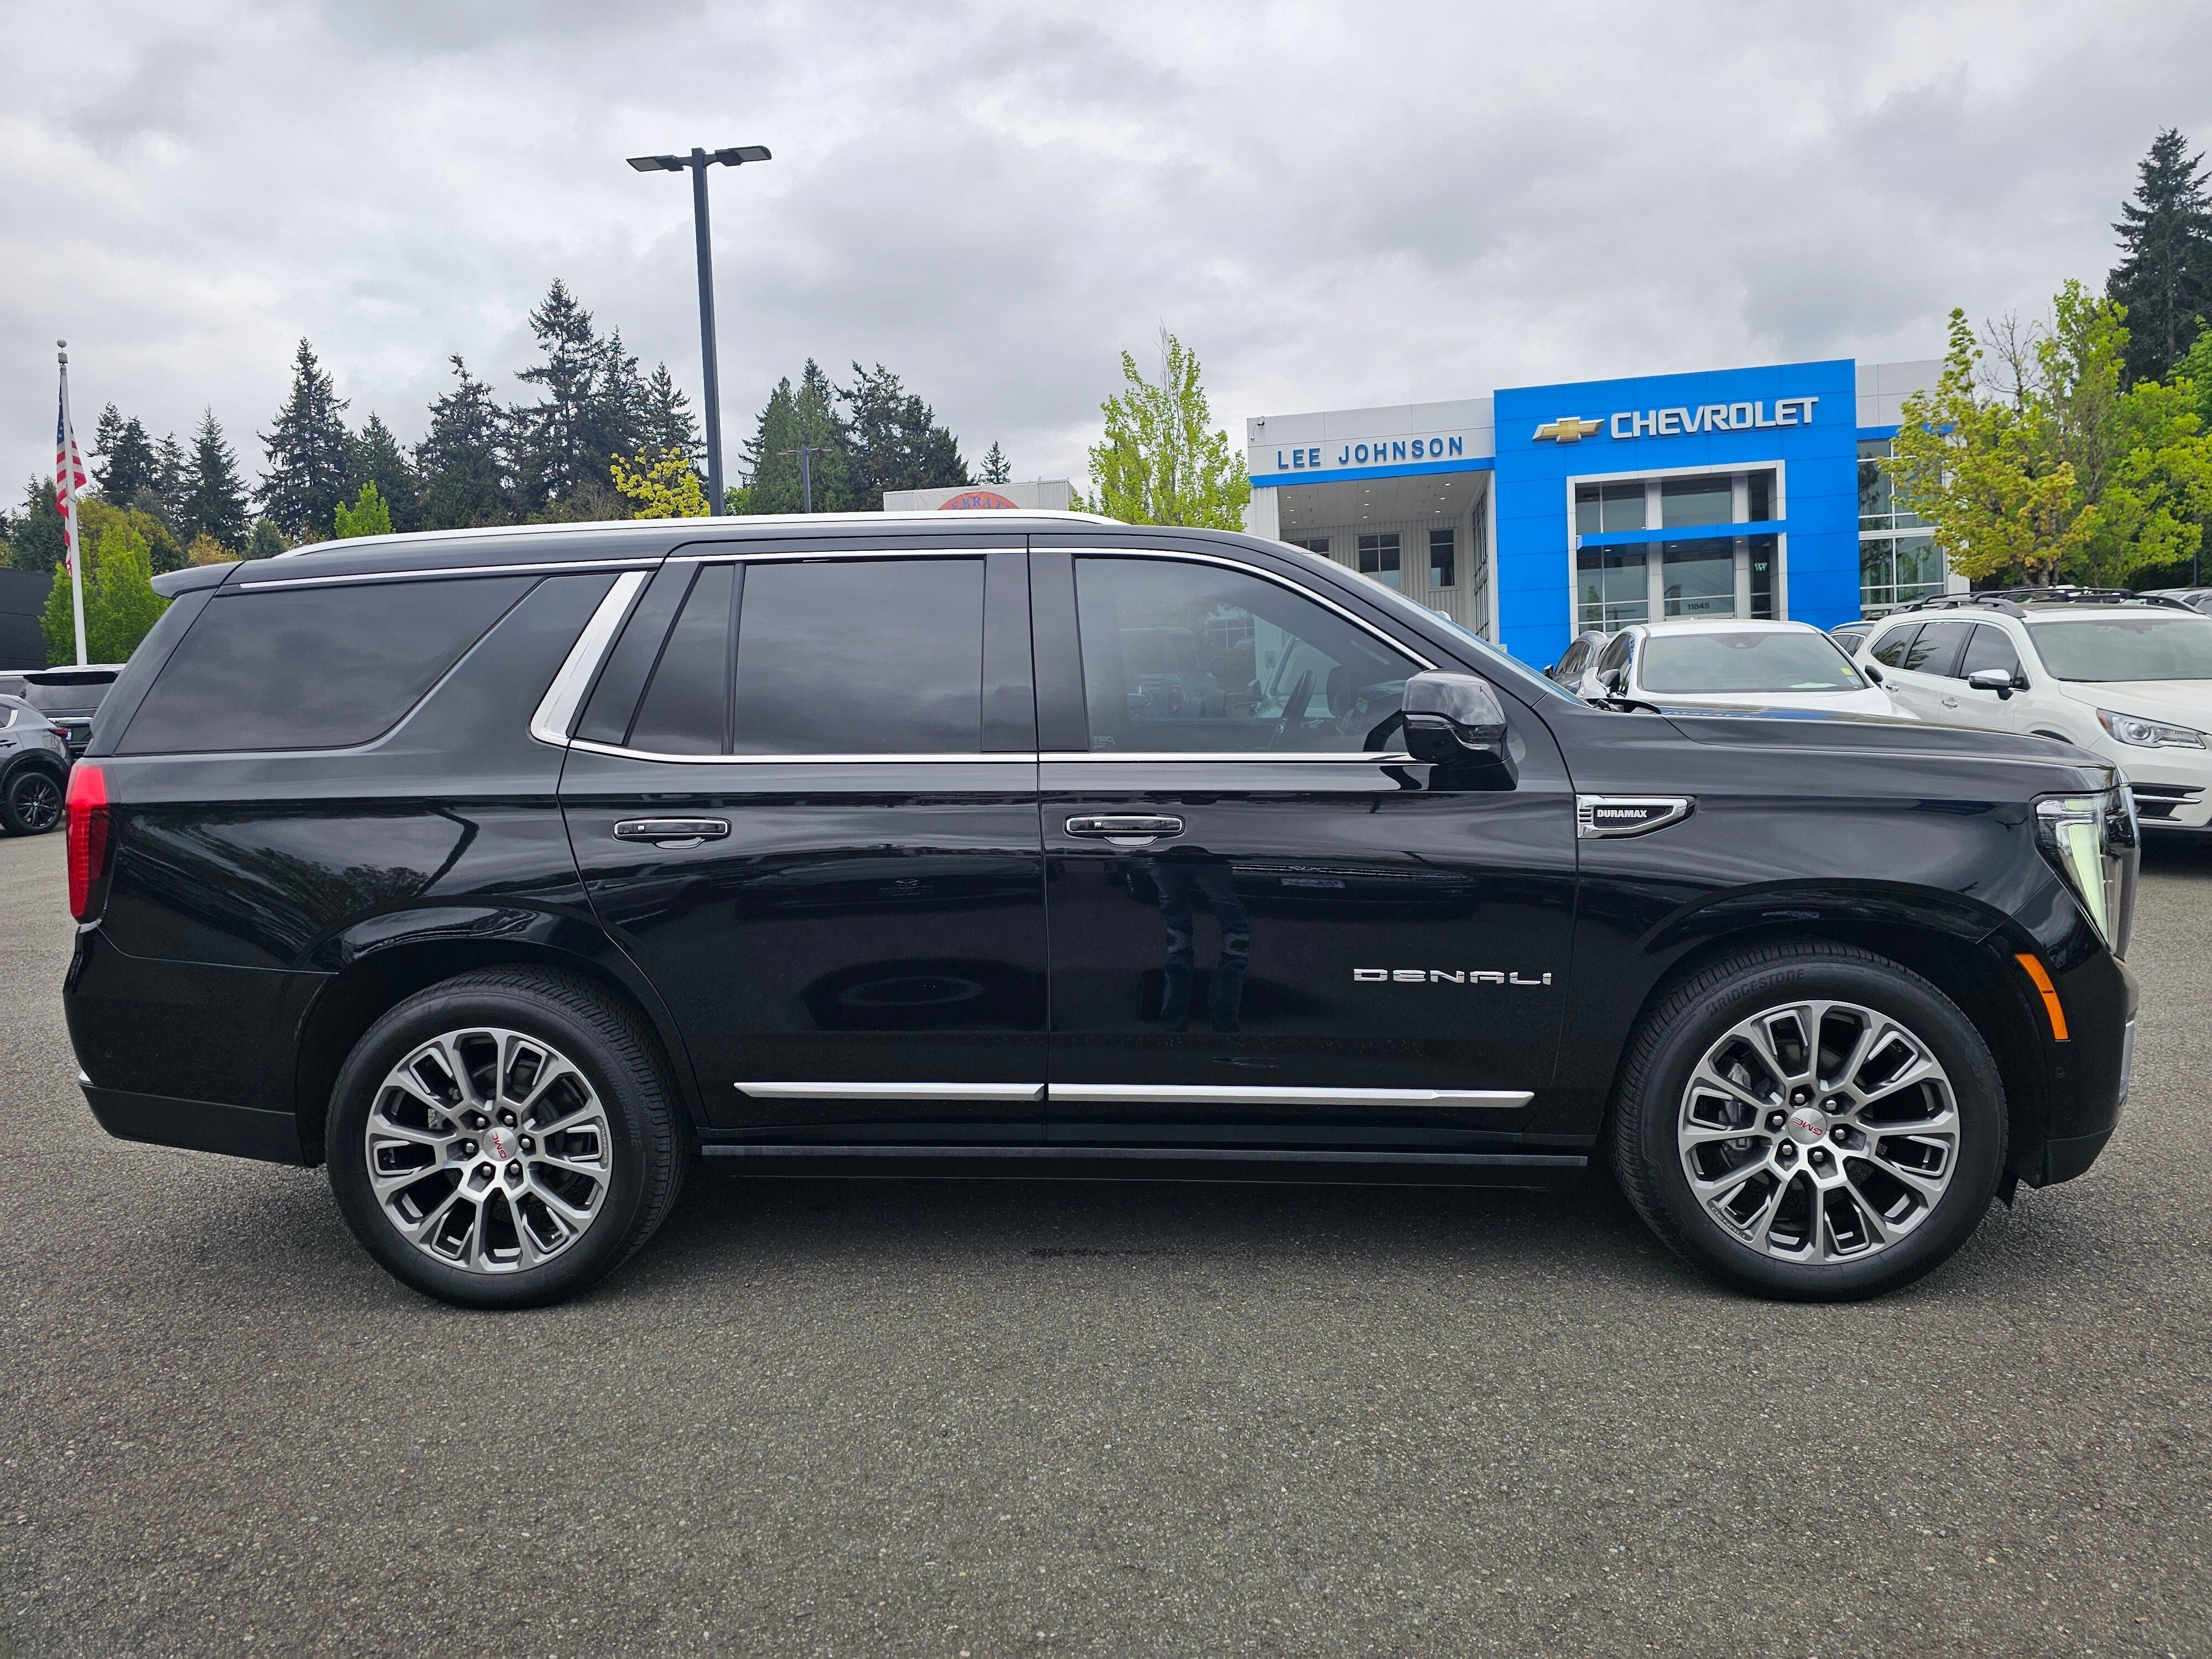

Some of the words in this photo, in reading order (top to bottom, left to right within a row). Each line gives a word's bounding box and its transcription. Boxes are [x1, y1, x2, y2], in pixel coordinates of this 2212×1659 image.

[1610, 397, 1819, 439] CHEVROLET
[1277, 447, 1321, 469] LEE
[1338, 436, 1463, 465] JOHNSON
[1755, 562, 1767, 571] W
[1597, 809, 1647, 818] DURAMAX
[1354, 968, 1552, 985] DENALI
[1705, 968, 1805, 1017] BRIDGESTONE
[1793, 1117, 1823, 1136] GMC
[491, 1131, 507, 1159] GMC
[1711, 1207, 1746, 1238] DENALI
